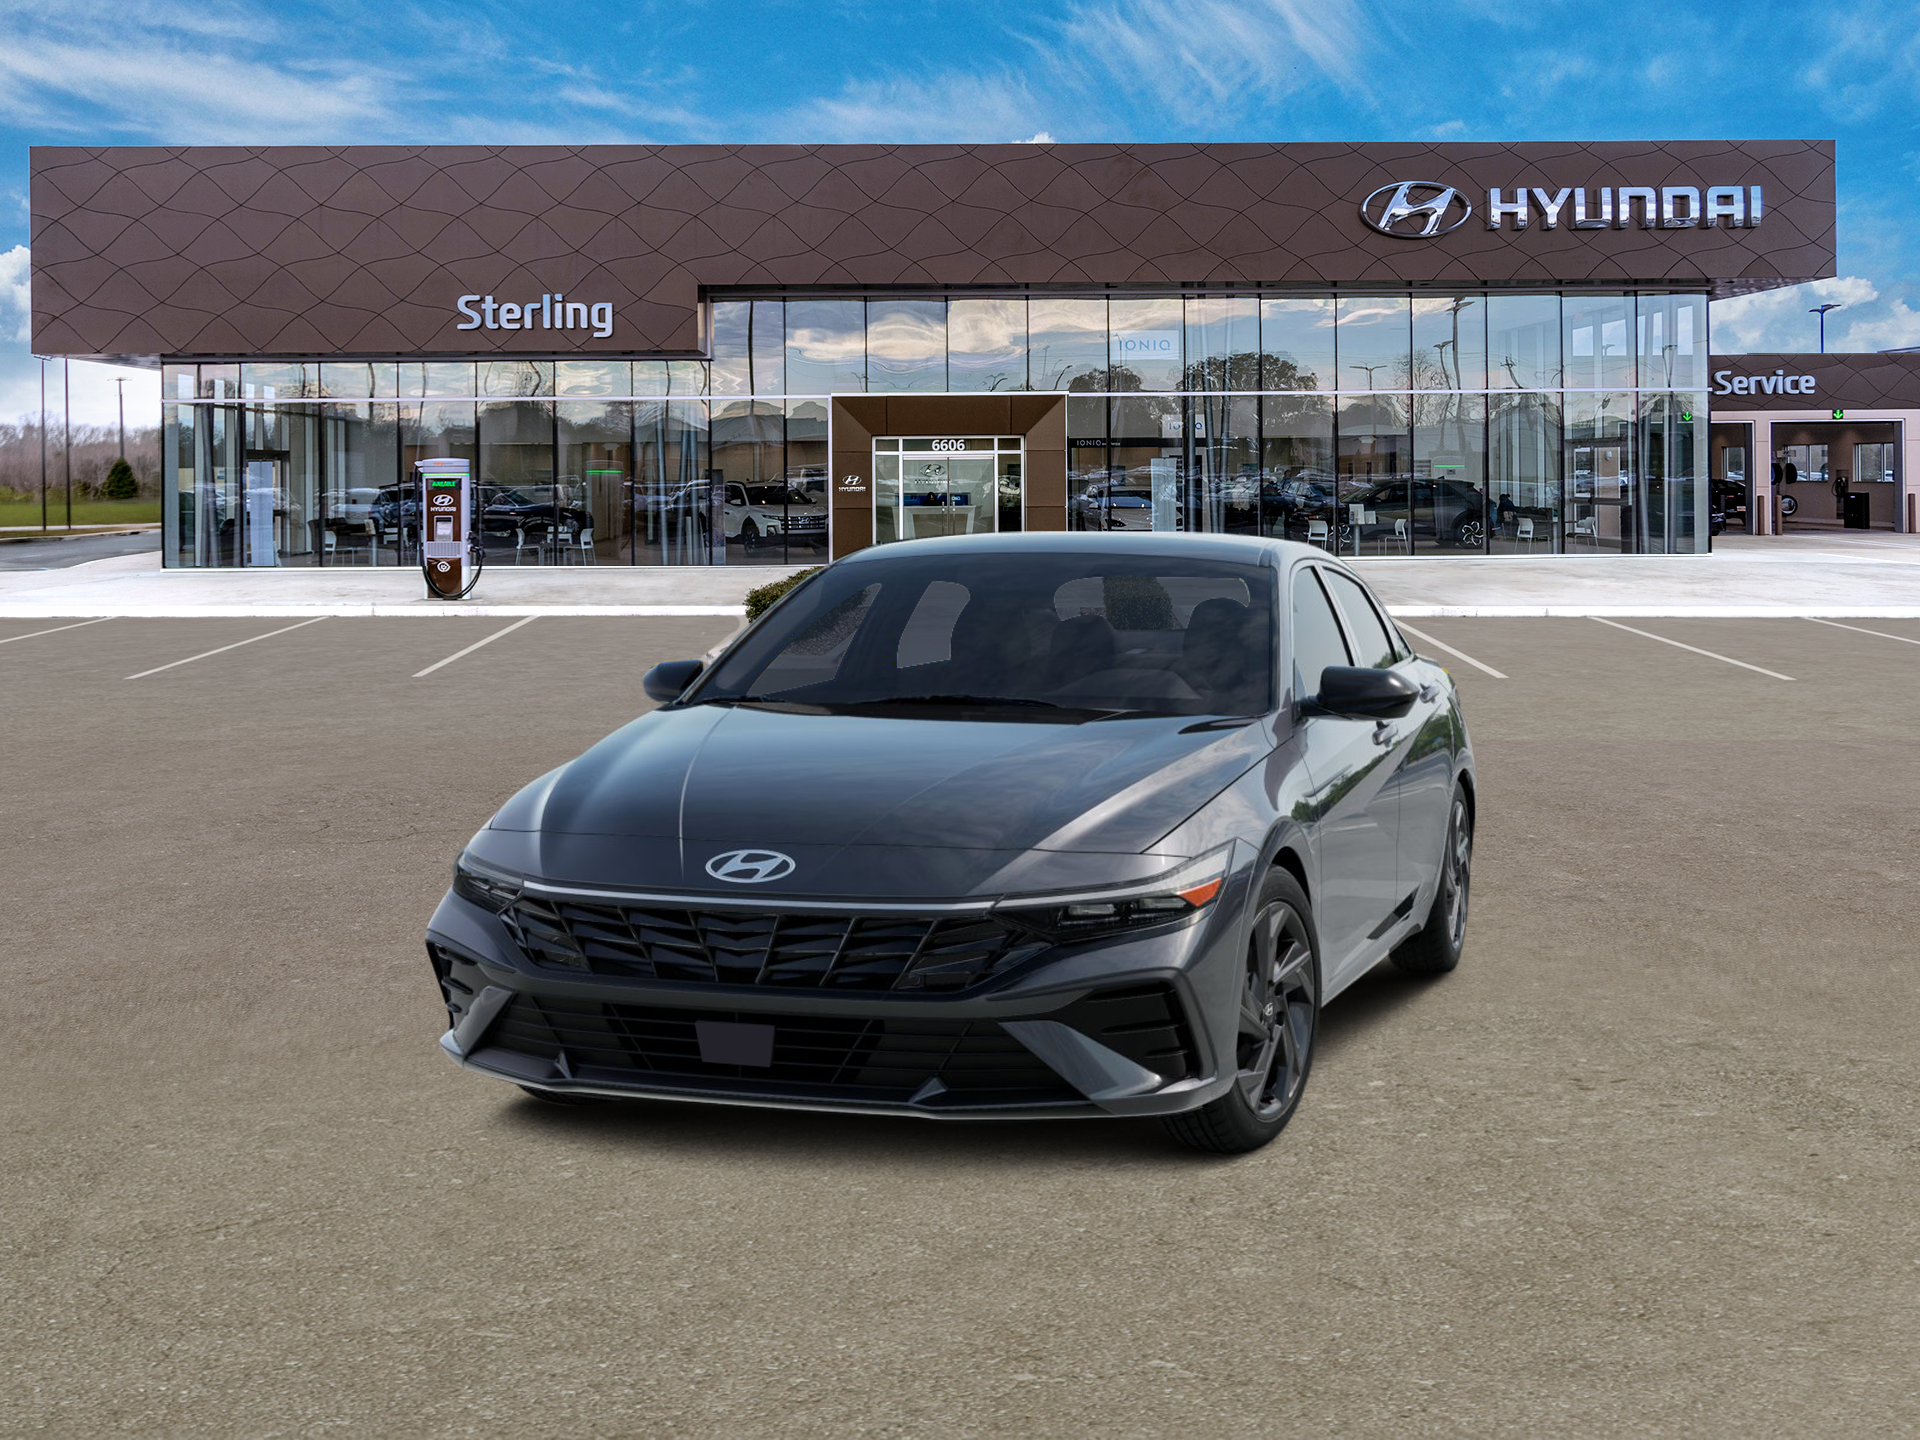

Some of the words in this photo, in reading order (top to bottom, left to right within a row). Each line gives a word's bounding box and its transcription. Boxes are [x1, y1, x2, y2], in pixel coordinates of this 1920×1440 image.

[1487, 185, 1763, 230] HYUNDAI
[456, 293, 614, 338] Sterling
[1119, 339, 1171, 351] IONIQ
[1713, 369, 1817, 395] Service
[931, 439, 966, 451] 6606
